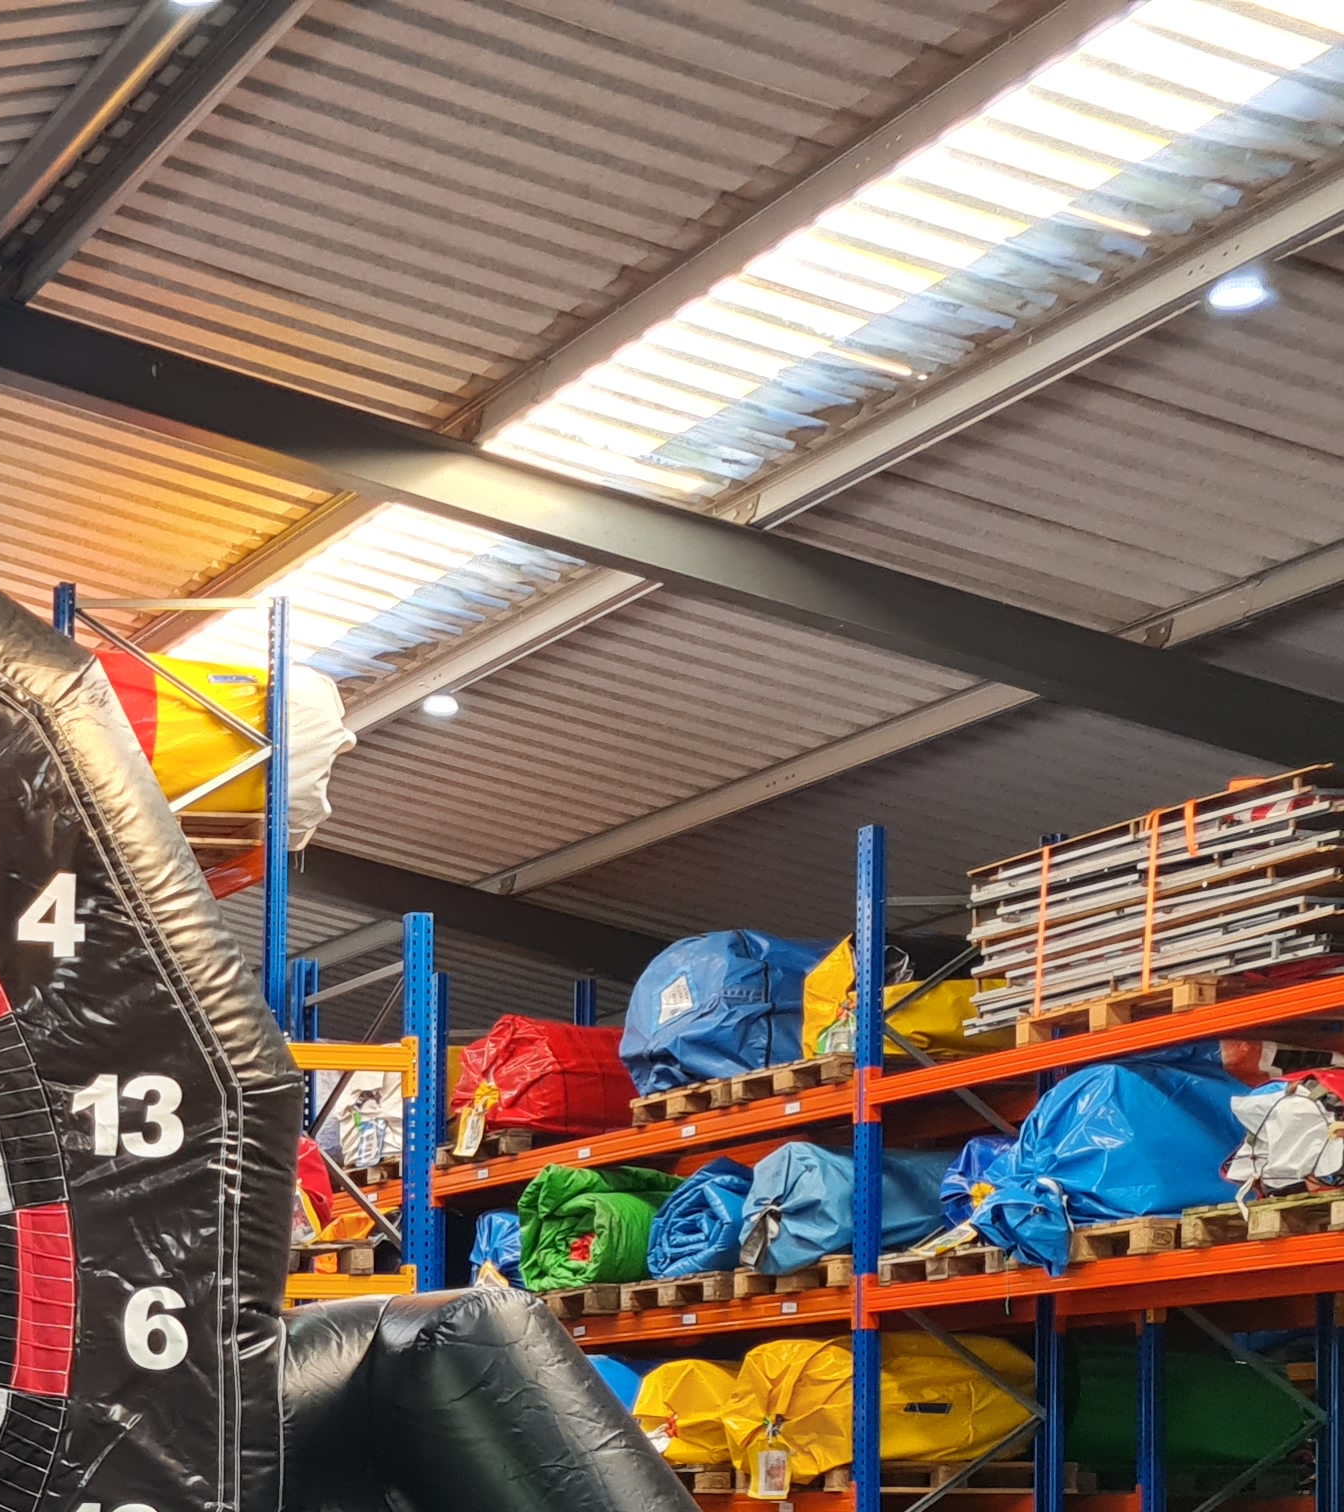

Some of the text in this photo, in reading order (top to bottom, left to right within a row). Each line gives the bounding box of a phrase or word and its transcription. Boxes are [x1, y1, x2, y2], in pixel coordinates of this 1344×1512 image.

[17, 873, 85, 962] 4
[69, 1074, 184, 1157] 13
[124, 1286, 188, 1370] 6
